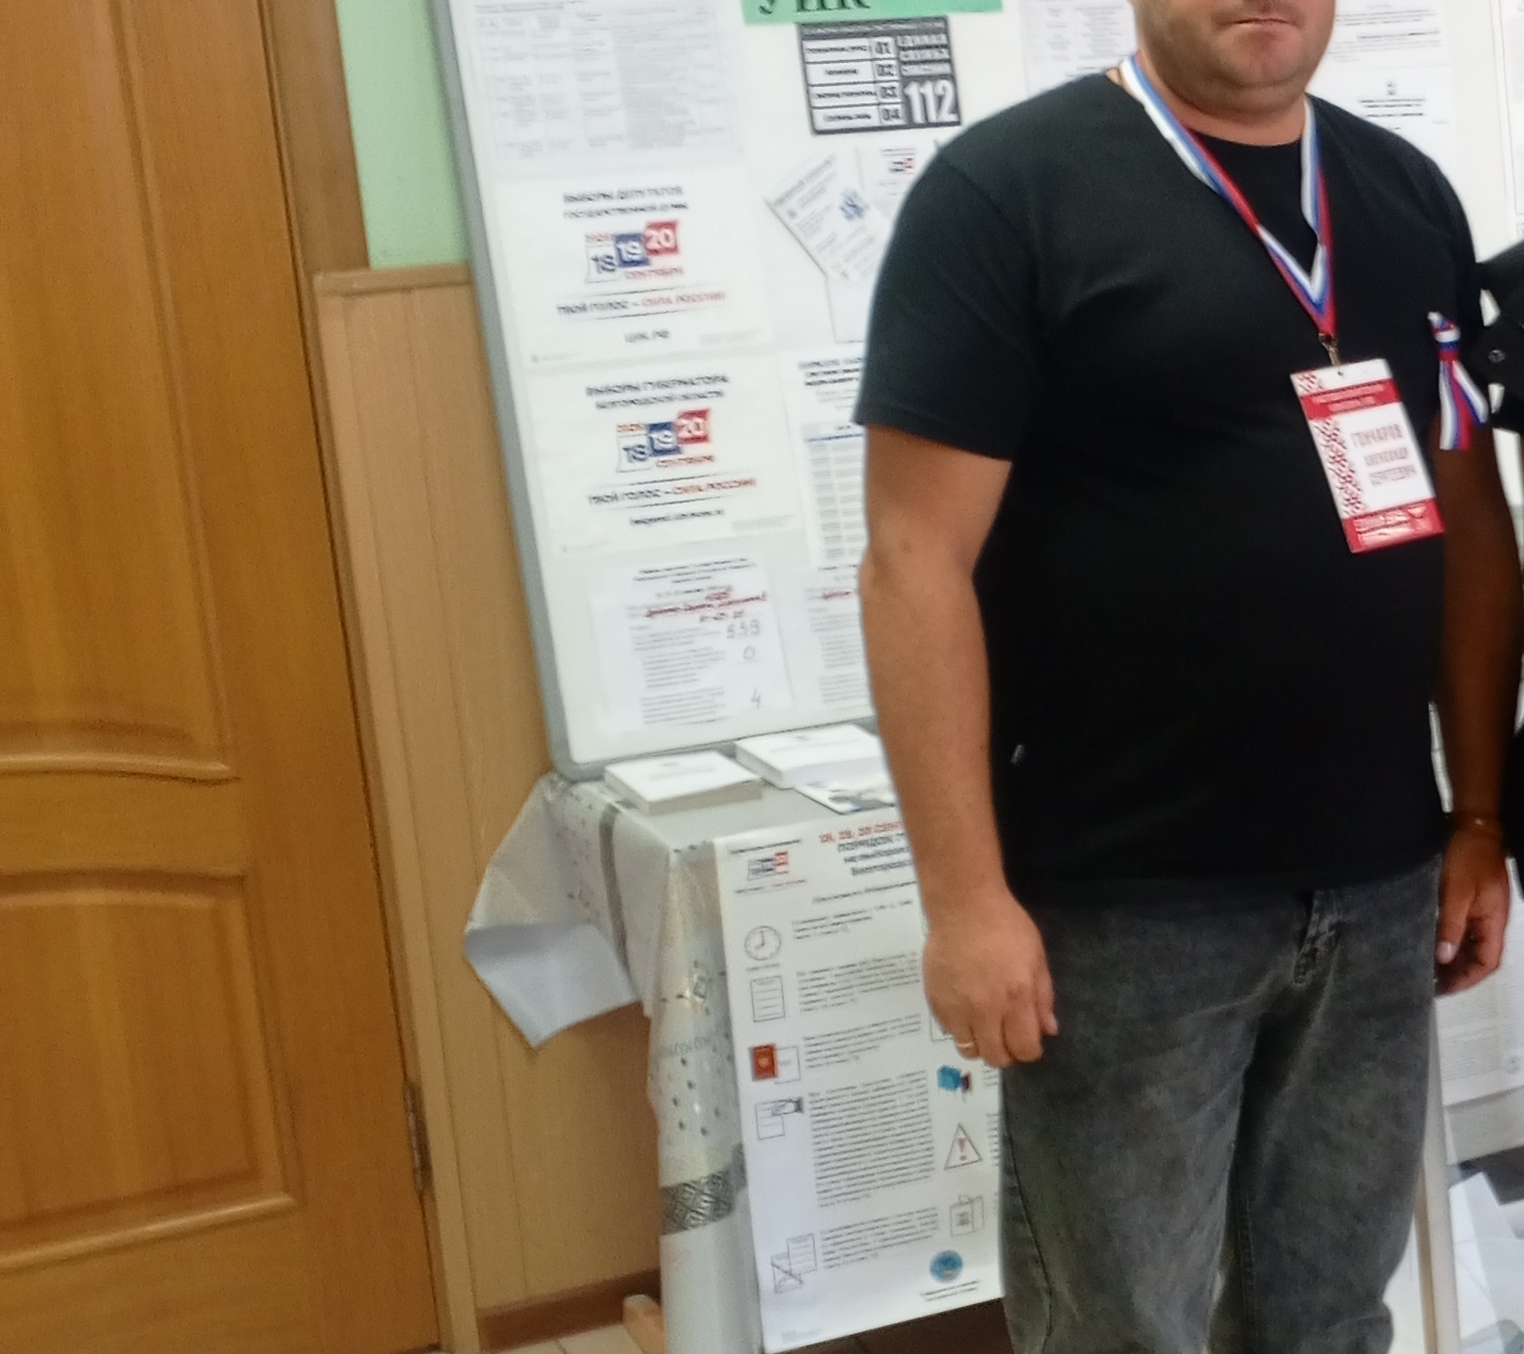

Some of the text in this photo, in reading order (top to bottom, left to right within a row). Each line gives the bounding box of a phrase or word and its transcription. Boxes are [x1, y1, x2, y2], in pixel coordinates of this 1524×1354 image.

[903, 79, 960, 124] 112
[645, 228, 676, 251] 20
[617, 240, 643, 263] 19
[591, 254, 617, 275] 18
[677, 417, 705, 439] 20
